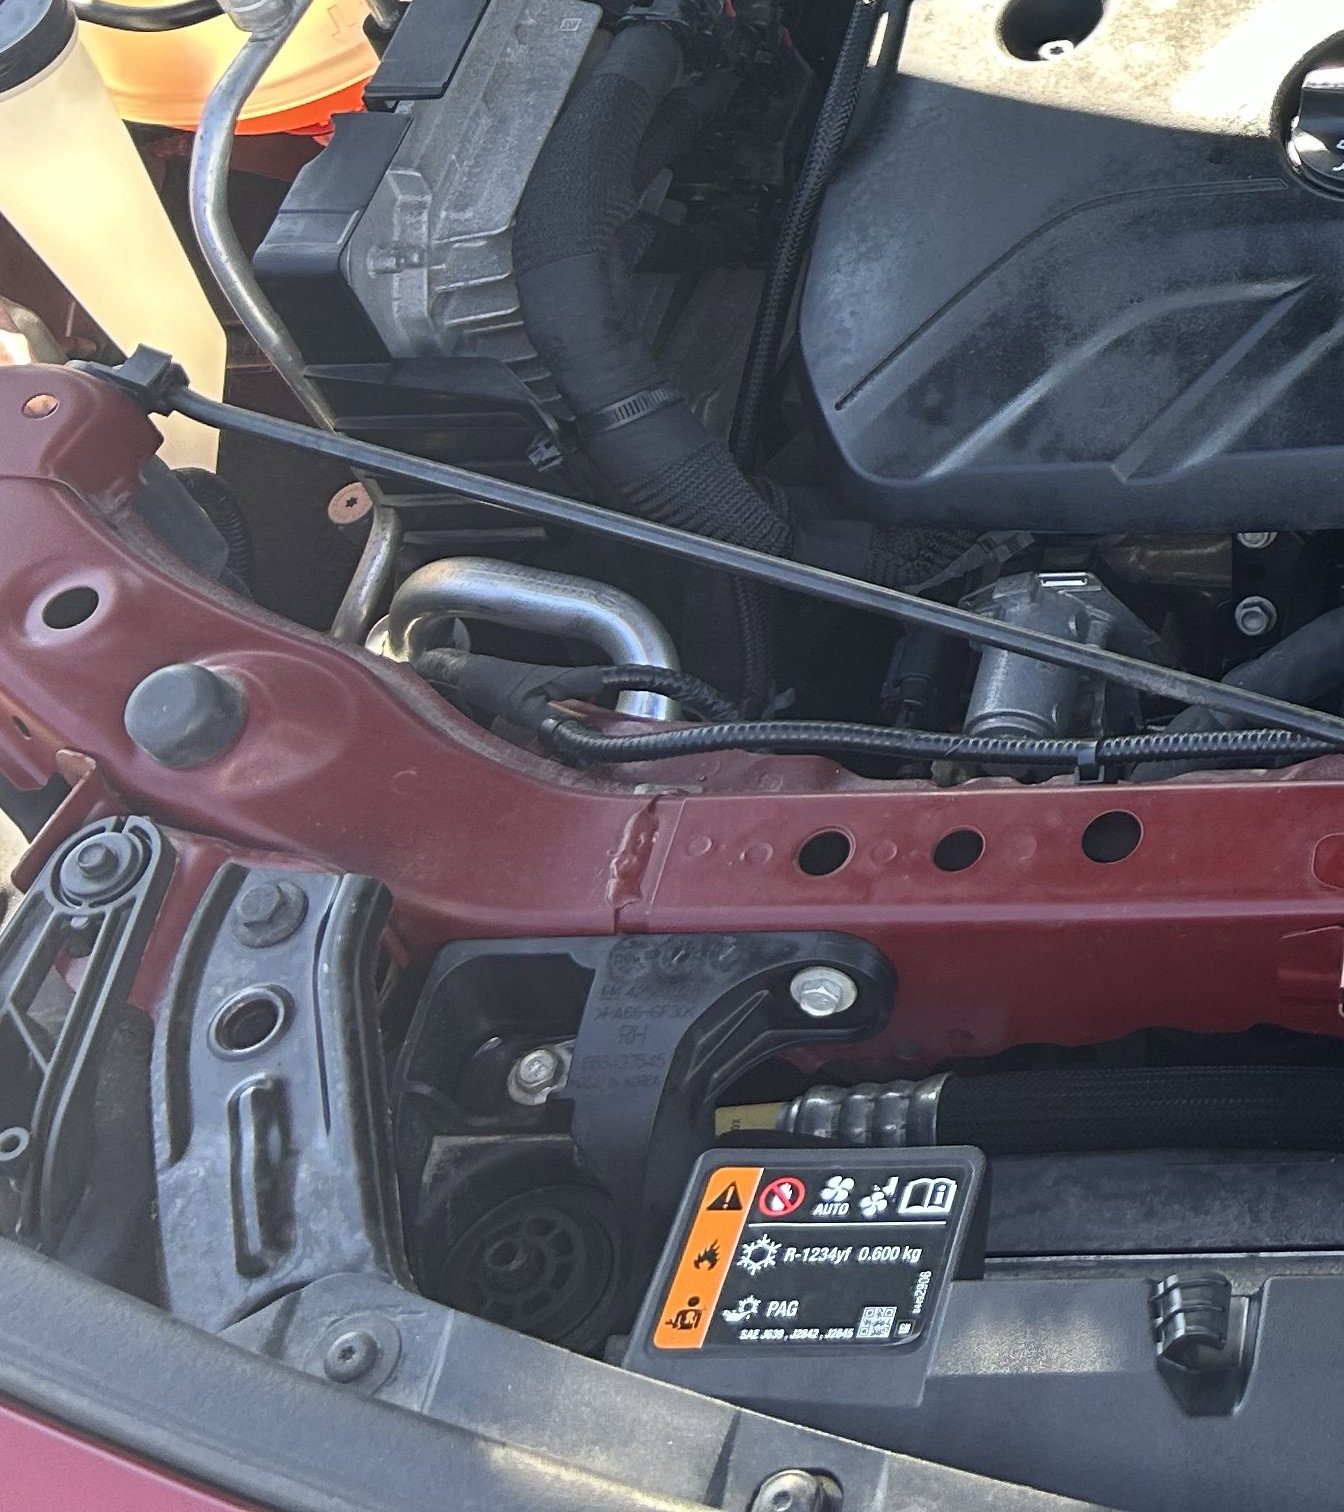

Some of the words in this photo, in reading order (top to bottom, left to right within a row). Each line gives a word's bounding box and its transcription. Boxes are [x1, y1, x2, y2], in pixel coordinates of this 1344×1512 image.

[617, 1024, 652, 1046] RH
[812, 1201, 850, 1216] AUTO
[784, 1247, 852, 1265] R-1234yf
[858, 1246, 901, 1262] 0.600
[901, 1246, 922, 1265] kg
[766, 1300, 800, 1317] PAG
